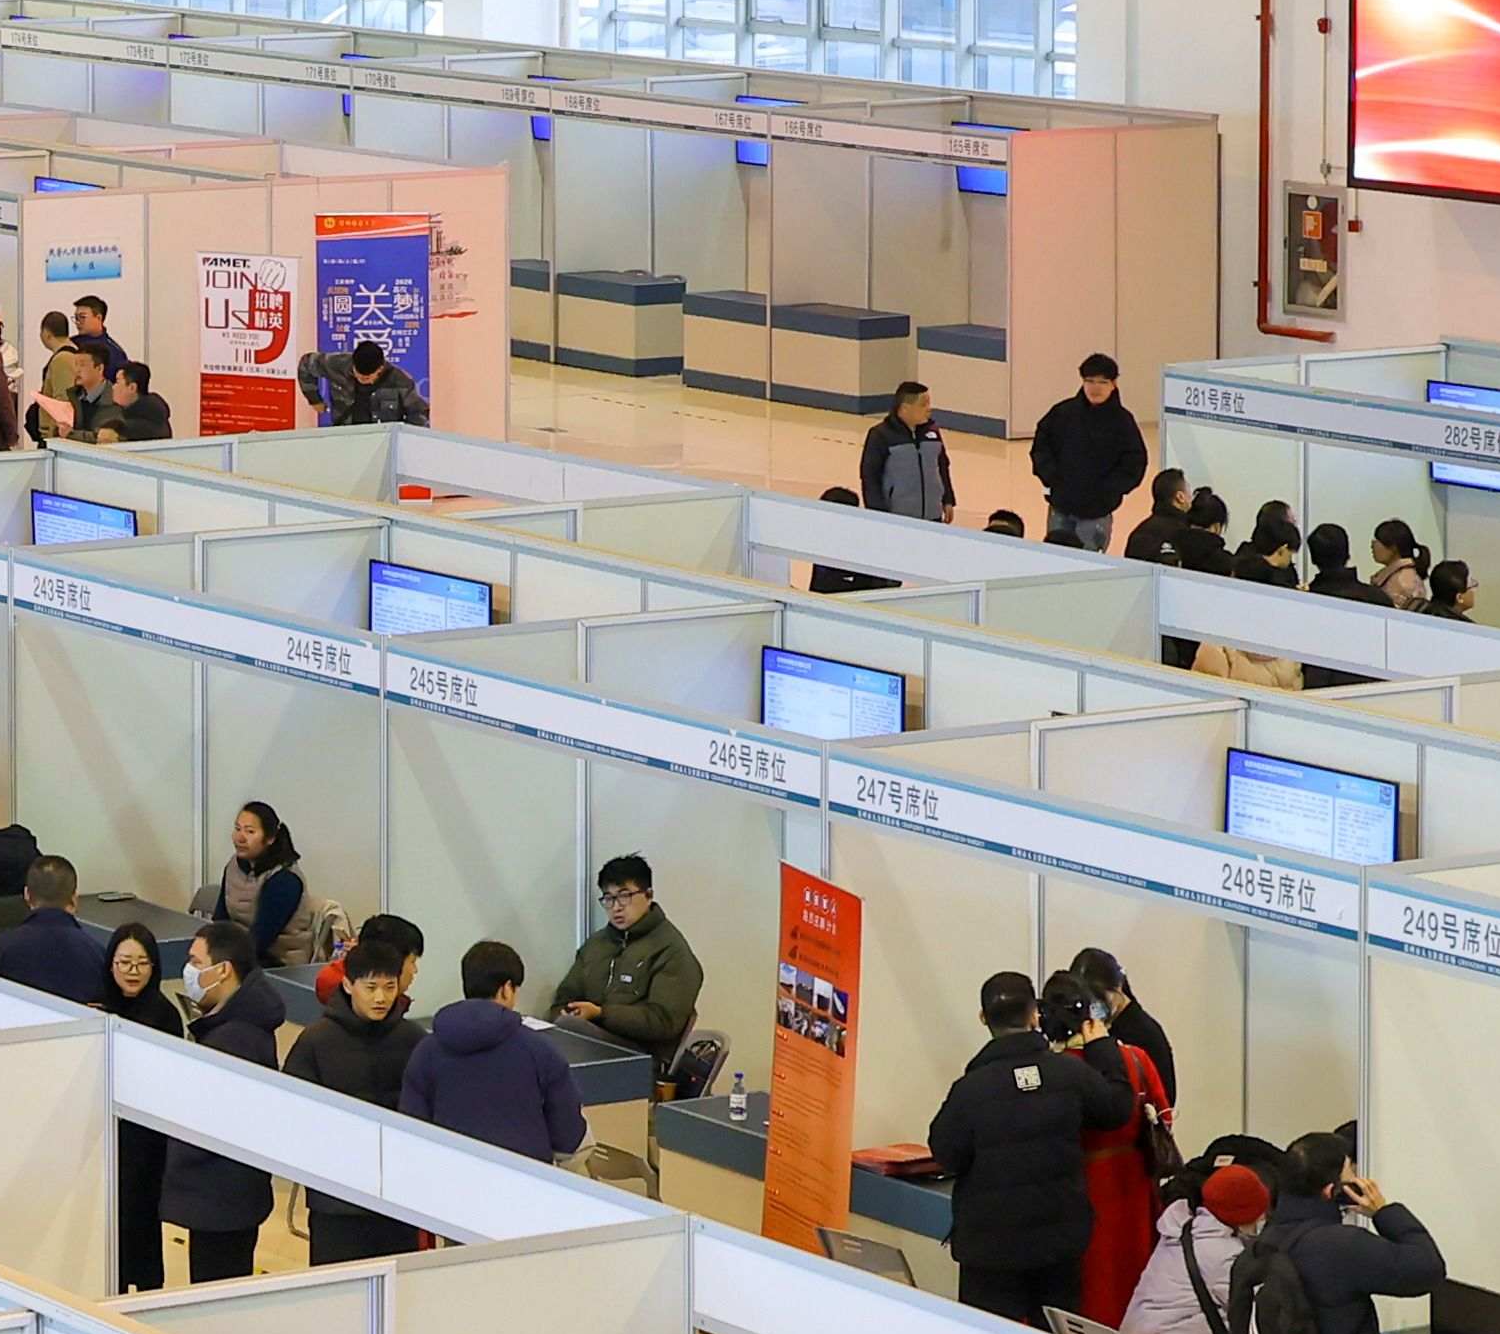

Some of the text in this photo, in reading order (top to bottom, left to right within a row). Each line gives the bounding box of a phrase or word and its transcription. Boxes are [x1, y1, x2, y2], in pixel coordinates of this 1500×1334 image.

[255, 292, 284, 311] 招聘
[1185, 386, 1246, 415] 281号席位
[33, 576, 92, 612] 243号席位
[287, 637, 352, 675] 244号席位
[410, 665, 478, 708] 245号席位
[709, 738, 787, 783] 246号席位
[857, 775, 940, 822] 247号席位
[1221, 861, 1317, 913] 248号席位
